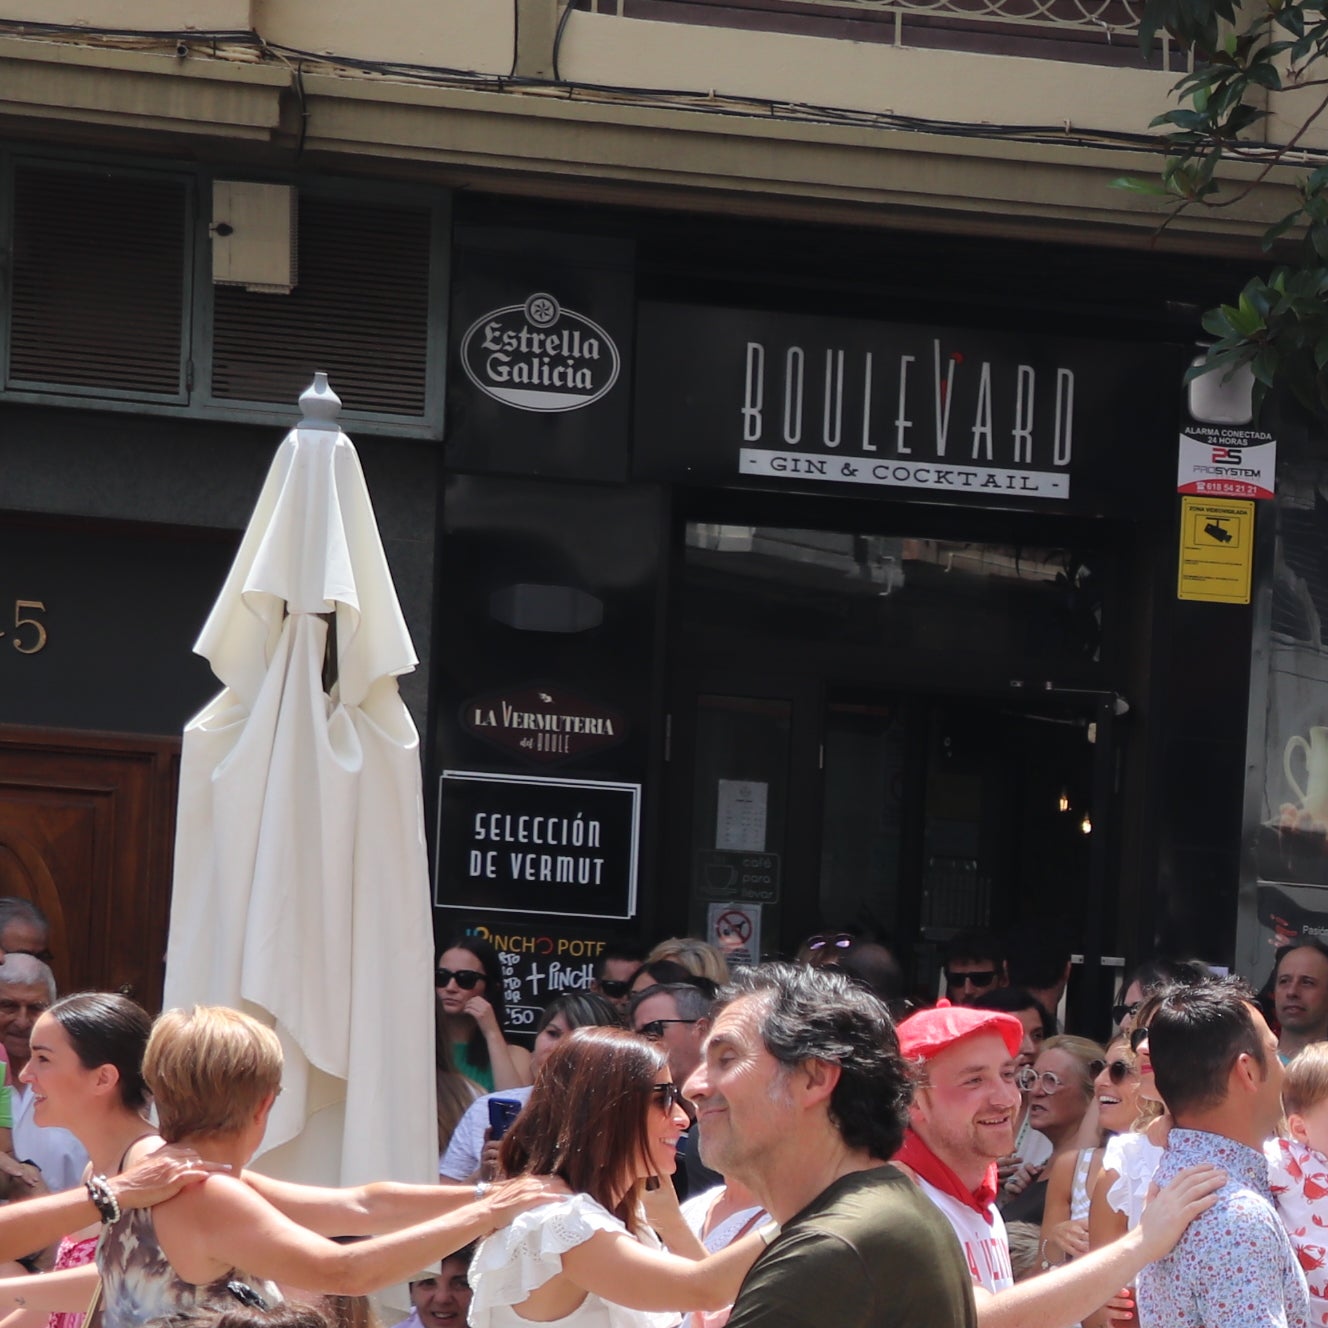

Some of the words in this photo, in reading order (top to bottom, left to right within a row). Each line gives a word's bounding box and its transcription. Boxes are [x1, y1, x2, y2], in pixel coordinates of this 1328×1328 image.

[481, 322, 600, 360] Estrella
[486, 352, 593, 390] Galicia
[741, 339, 1075, 466] BOULEVARD
[1184, 427, 1220, 437] ALARMA
[1221, 429, 1272, 440] CONECTADA
[1207, 436, 1217, 444] 24
[1218, 437, 1248, 446] HORAS
[769, 456, 828, 475] GIN
[840, 462, 859, 478] &
[872, 465, 1040, 491] COCKTAIL
[1193, 465, 1261, 478] PROSYSTEM
[474, 708, 498, 727] LA
[474, 812, 600, 848] SELECCIÓN
[470, 850, 497, 879] DE
[511, 852, 604, 885] VERMUT
